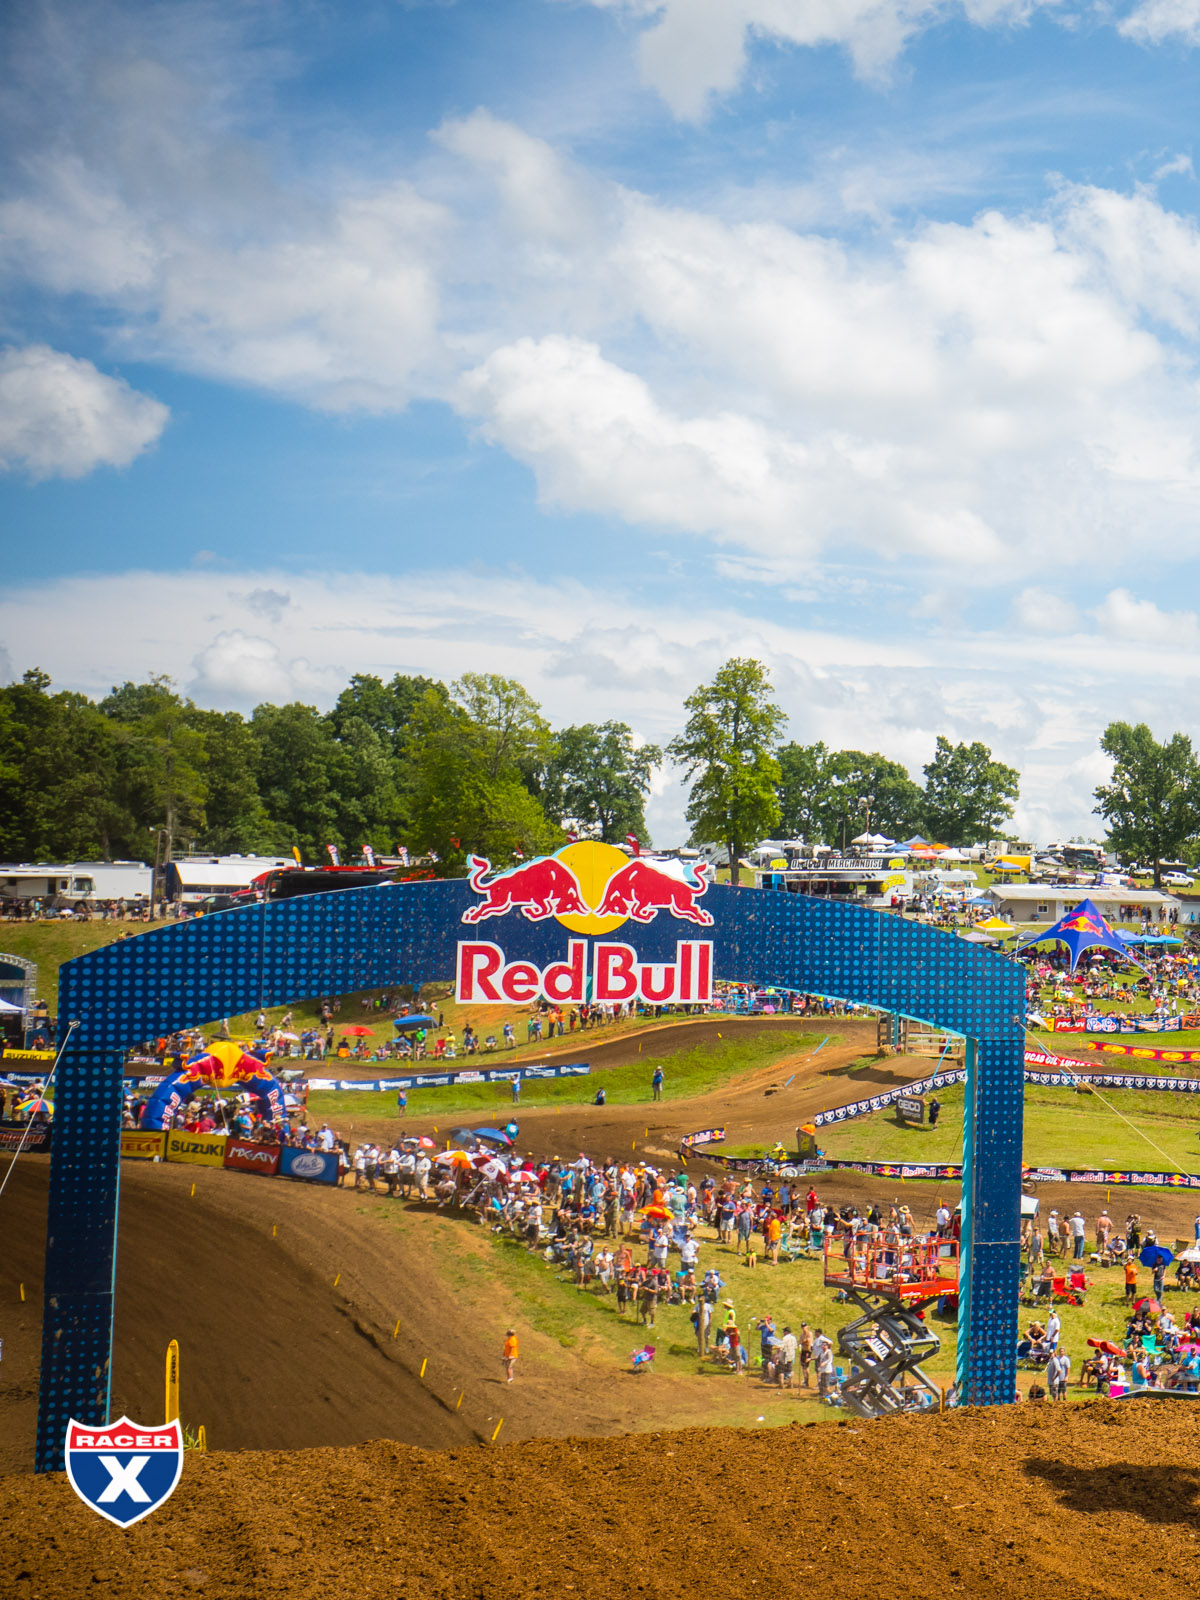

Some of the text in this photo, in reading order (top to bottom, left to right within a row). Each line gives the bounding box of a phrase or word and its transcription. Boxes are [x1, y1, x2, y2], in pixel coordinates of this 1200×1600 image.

[827, 859, 883, 870] MERCHANDISE
[457, 940, 713, 1004] Red Bull
[898, 1099, 921, 1112] GEICO
[171, 1140, 224, 1156] SUZUKI
[902, 1166, 936, 1177] Red Bull
[1070, 1172, 1103, 1182] Red Bull
[1131, 1174, 1163, 1184] Red Bull
